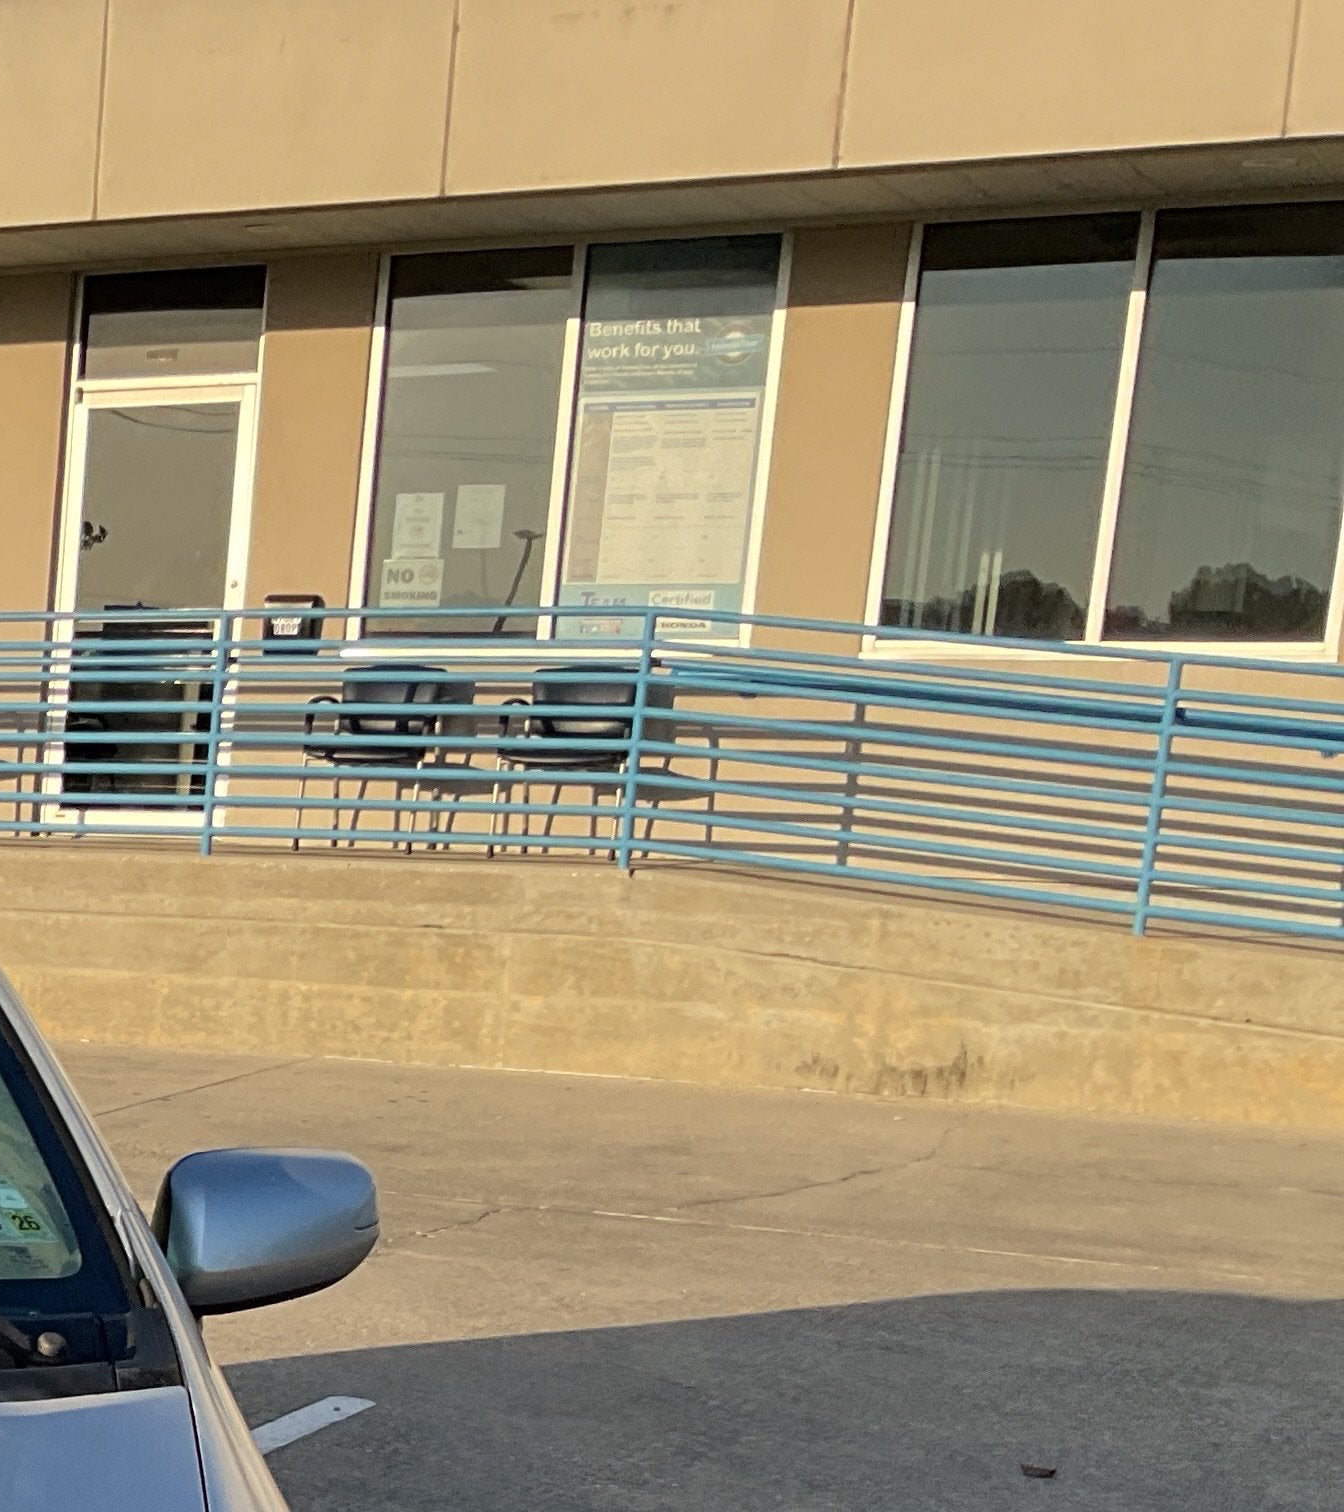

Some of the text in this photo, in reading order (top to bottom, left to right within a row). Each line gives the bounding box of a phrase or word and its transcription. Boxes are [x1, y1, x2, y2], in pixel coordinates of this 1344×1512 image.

[589, 317, 701, 337] Benefits that
[587, 343, 630, 359] work
[634, 342, 660, 358] for
[662, 342, 701, 360] you.
[386, 568, 415, 585] NO
[383, 590, 438, 601] SMOKING
[650, 591, 712, 606] Certified
[660, 621, 707, 630] HONDA
[11, 1214, 41, 1231] 26
